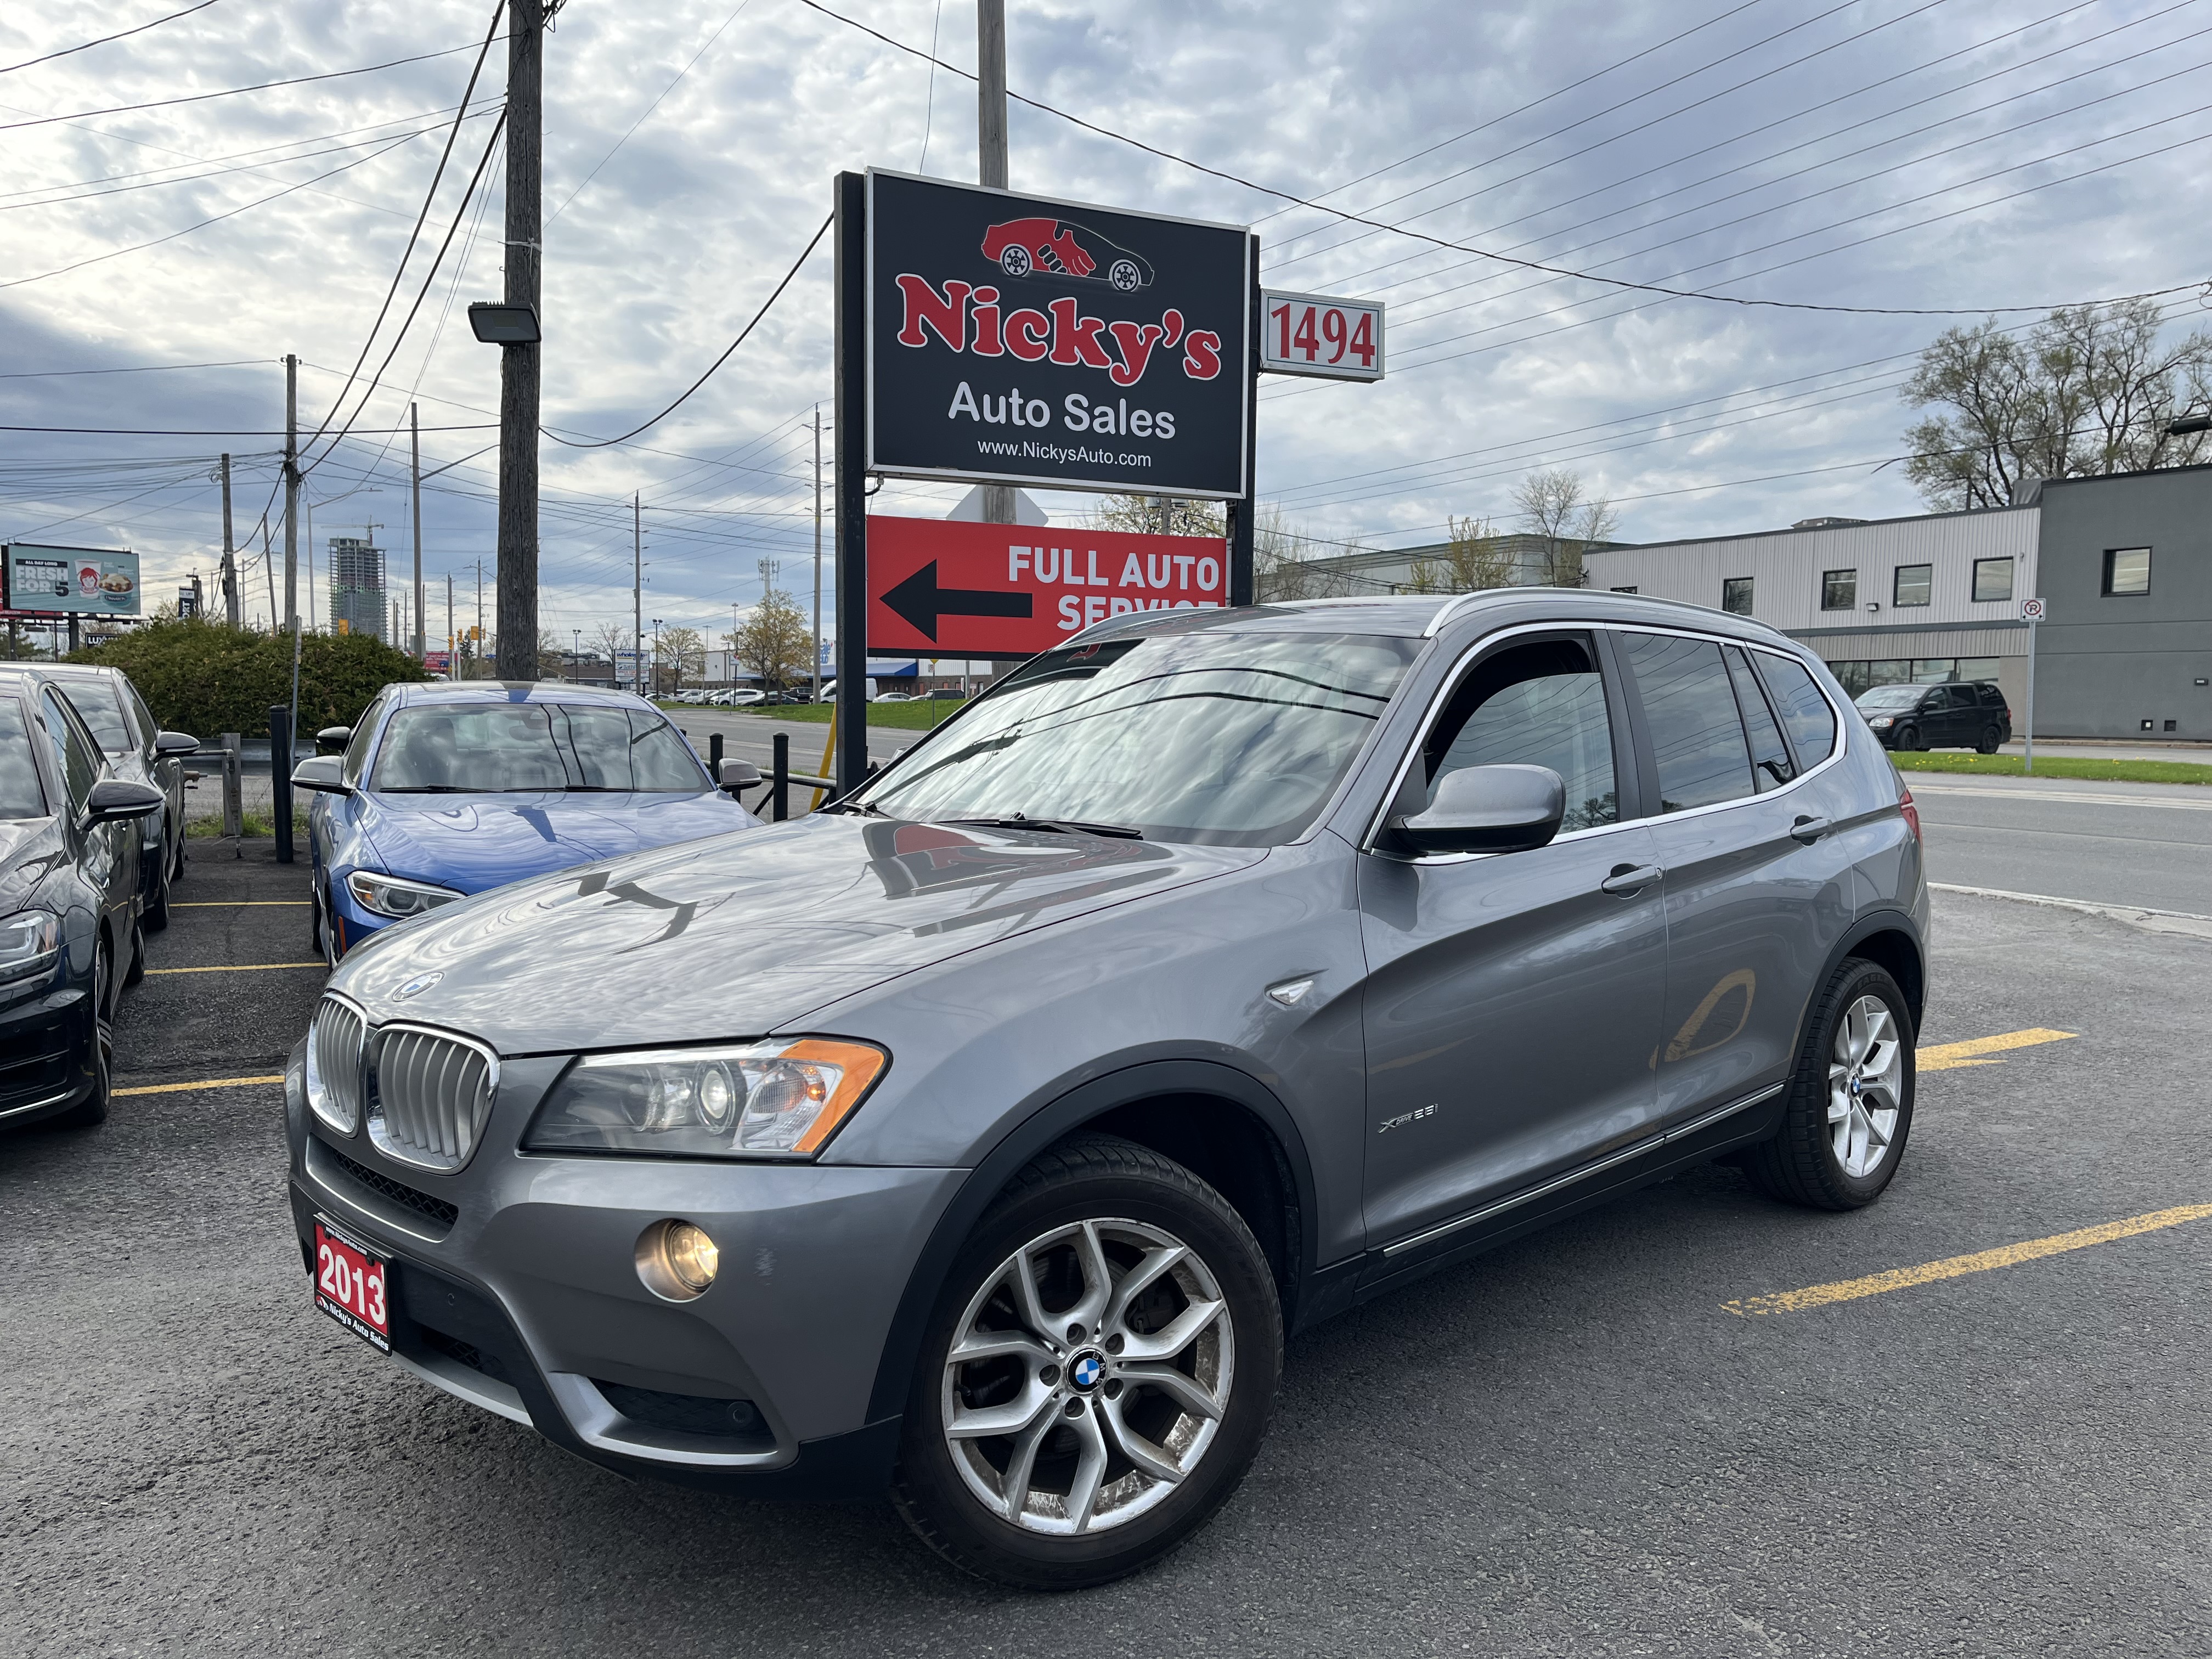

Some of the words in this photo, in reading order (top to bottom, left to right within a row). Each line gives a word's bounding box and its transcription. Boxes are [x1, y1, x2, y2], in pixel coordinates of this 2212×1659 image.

[895, 273, 1222, 386] Nicky's
[1271, 303, 1375, 367] 1494
[949, 382, 1050, 428] Auto
[1064, 393, 1176, 439] Sales
[978, 441, 1152, 467] www.NickysAuto.com
[15, 566, 68, 580] FRESH
[16, 579, 50, 592] FOR
[55, 582, 69, 596] 5
[1009, 546, 1109, 586] FULL
[1119, 553, 1219, 591] AUTO
[319, 1244, 386, 1325] 2013
[330, 1303, 352, 1326] Nicky's
[353, 1319, 369, 1338] Auto
[370, 1331, 389, 1351] Sales
